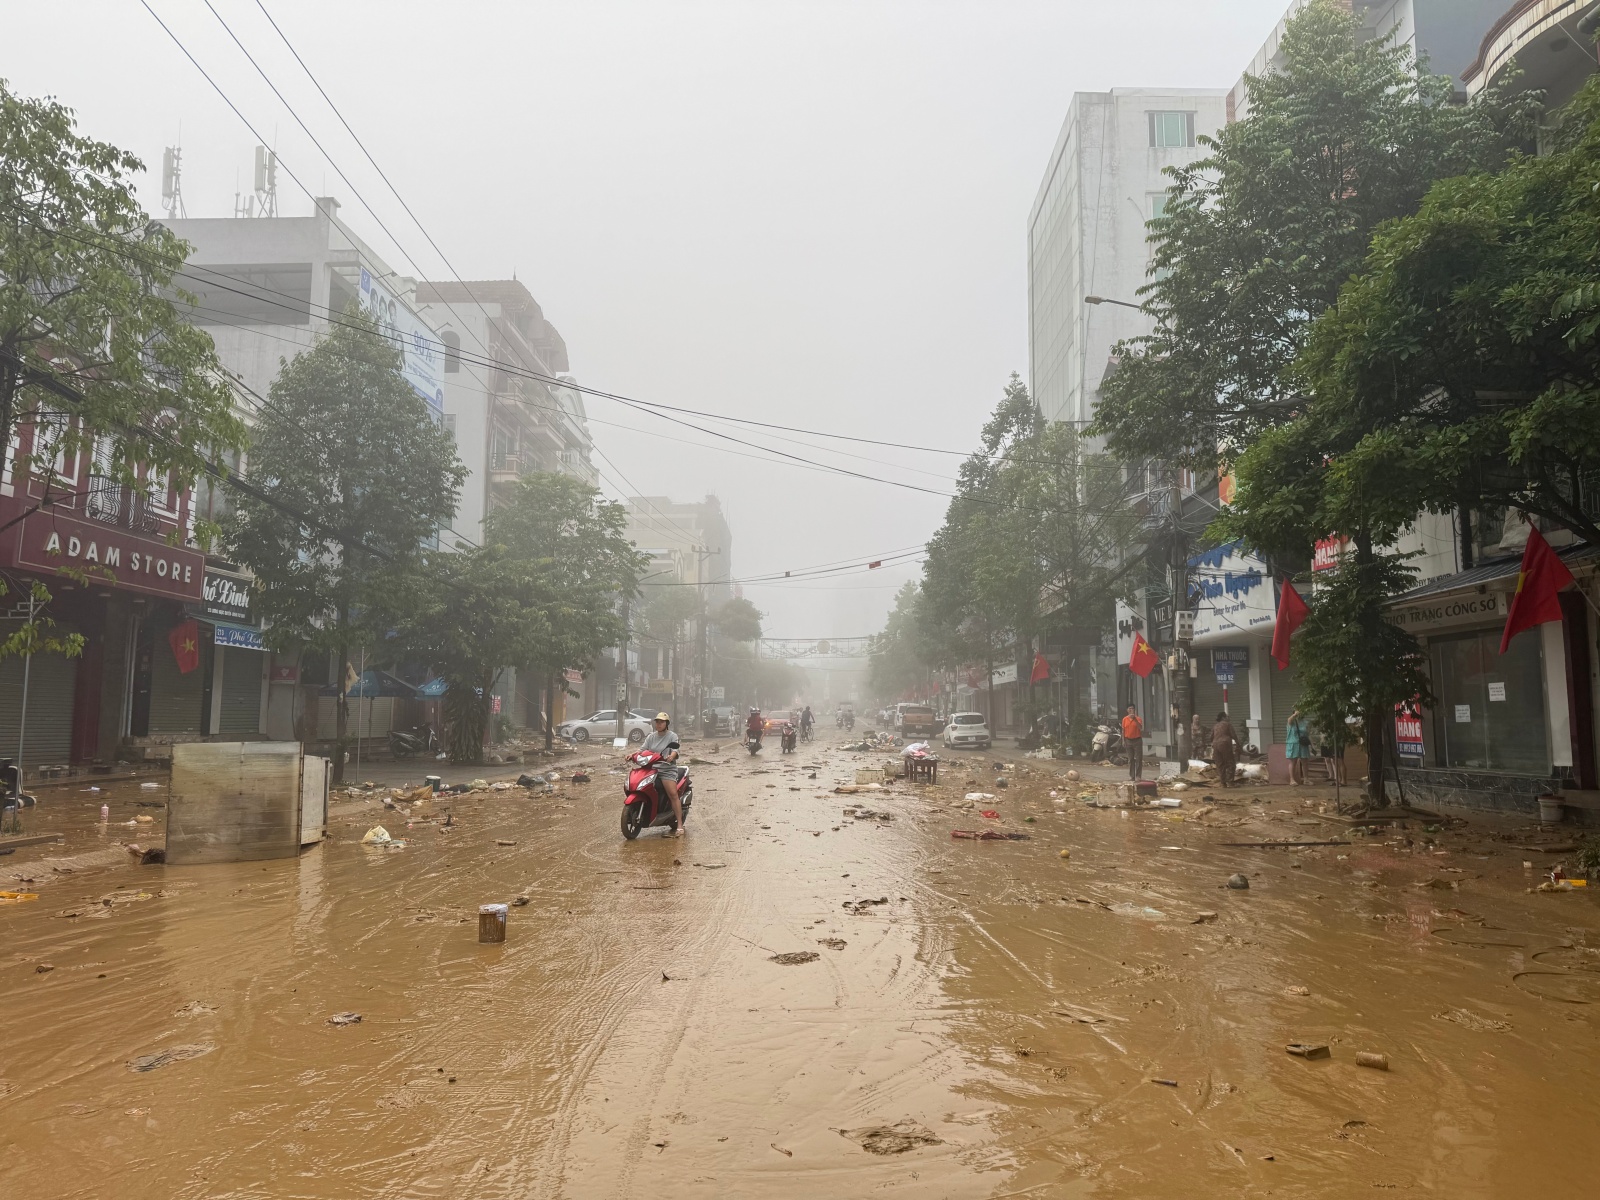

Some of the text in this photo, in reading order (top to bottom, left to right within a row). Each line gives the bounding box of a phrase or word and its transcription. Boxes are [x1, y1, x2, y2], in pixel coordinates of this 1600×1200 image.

[45, 531, 192, 583] ADAM STORE
[1445, 602, 1477, 617] CÔNG
[1479, 594, 1497, 611] SỞ
[1397, 719, 1421, 738] HÀNG
